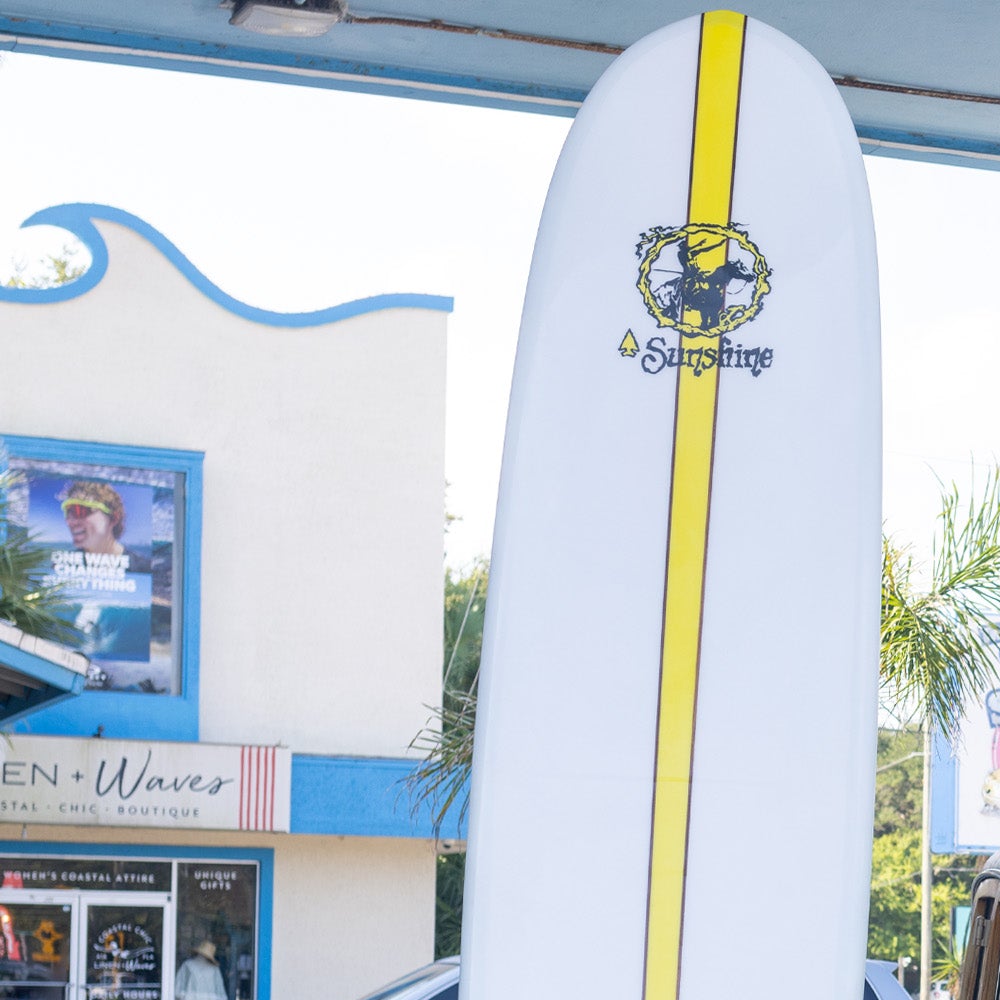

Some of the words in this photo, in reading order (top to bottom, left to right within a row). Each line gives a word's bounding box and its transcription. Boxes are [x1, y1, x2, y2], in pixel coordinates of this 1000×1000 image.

[641, 336, 774, 377] Sunshine
[51, 551, 84, 566] ONE
[85, 552, 130, 569] WAVE
[54, 564, 126, 579] CHANGES
[95, 750, 234, 799] Waves
[59, 803, 97, 815] CHIC
[118, 806, 201, 819] BOUTIQUE
[3, 870, 57, 881] WOMEN'S
[61, 872, 111, 883] COASTAL
[115, 874, 155, 884] ATTIRE
[194, 870, 237, 881] UNIQUE
[200, 881, 231, 891] GIFTS
